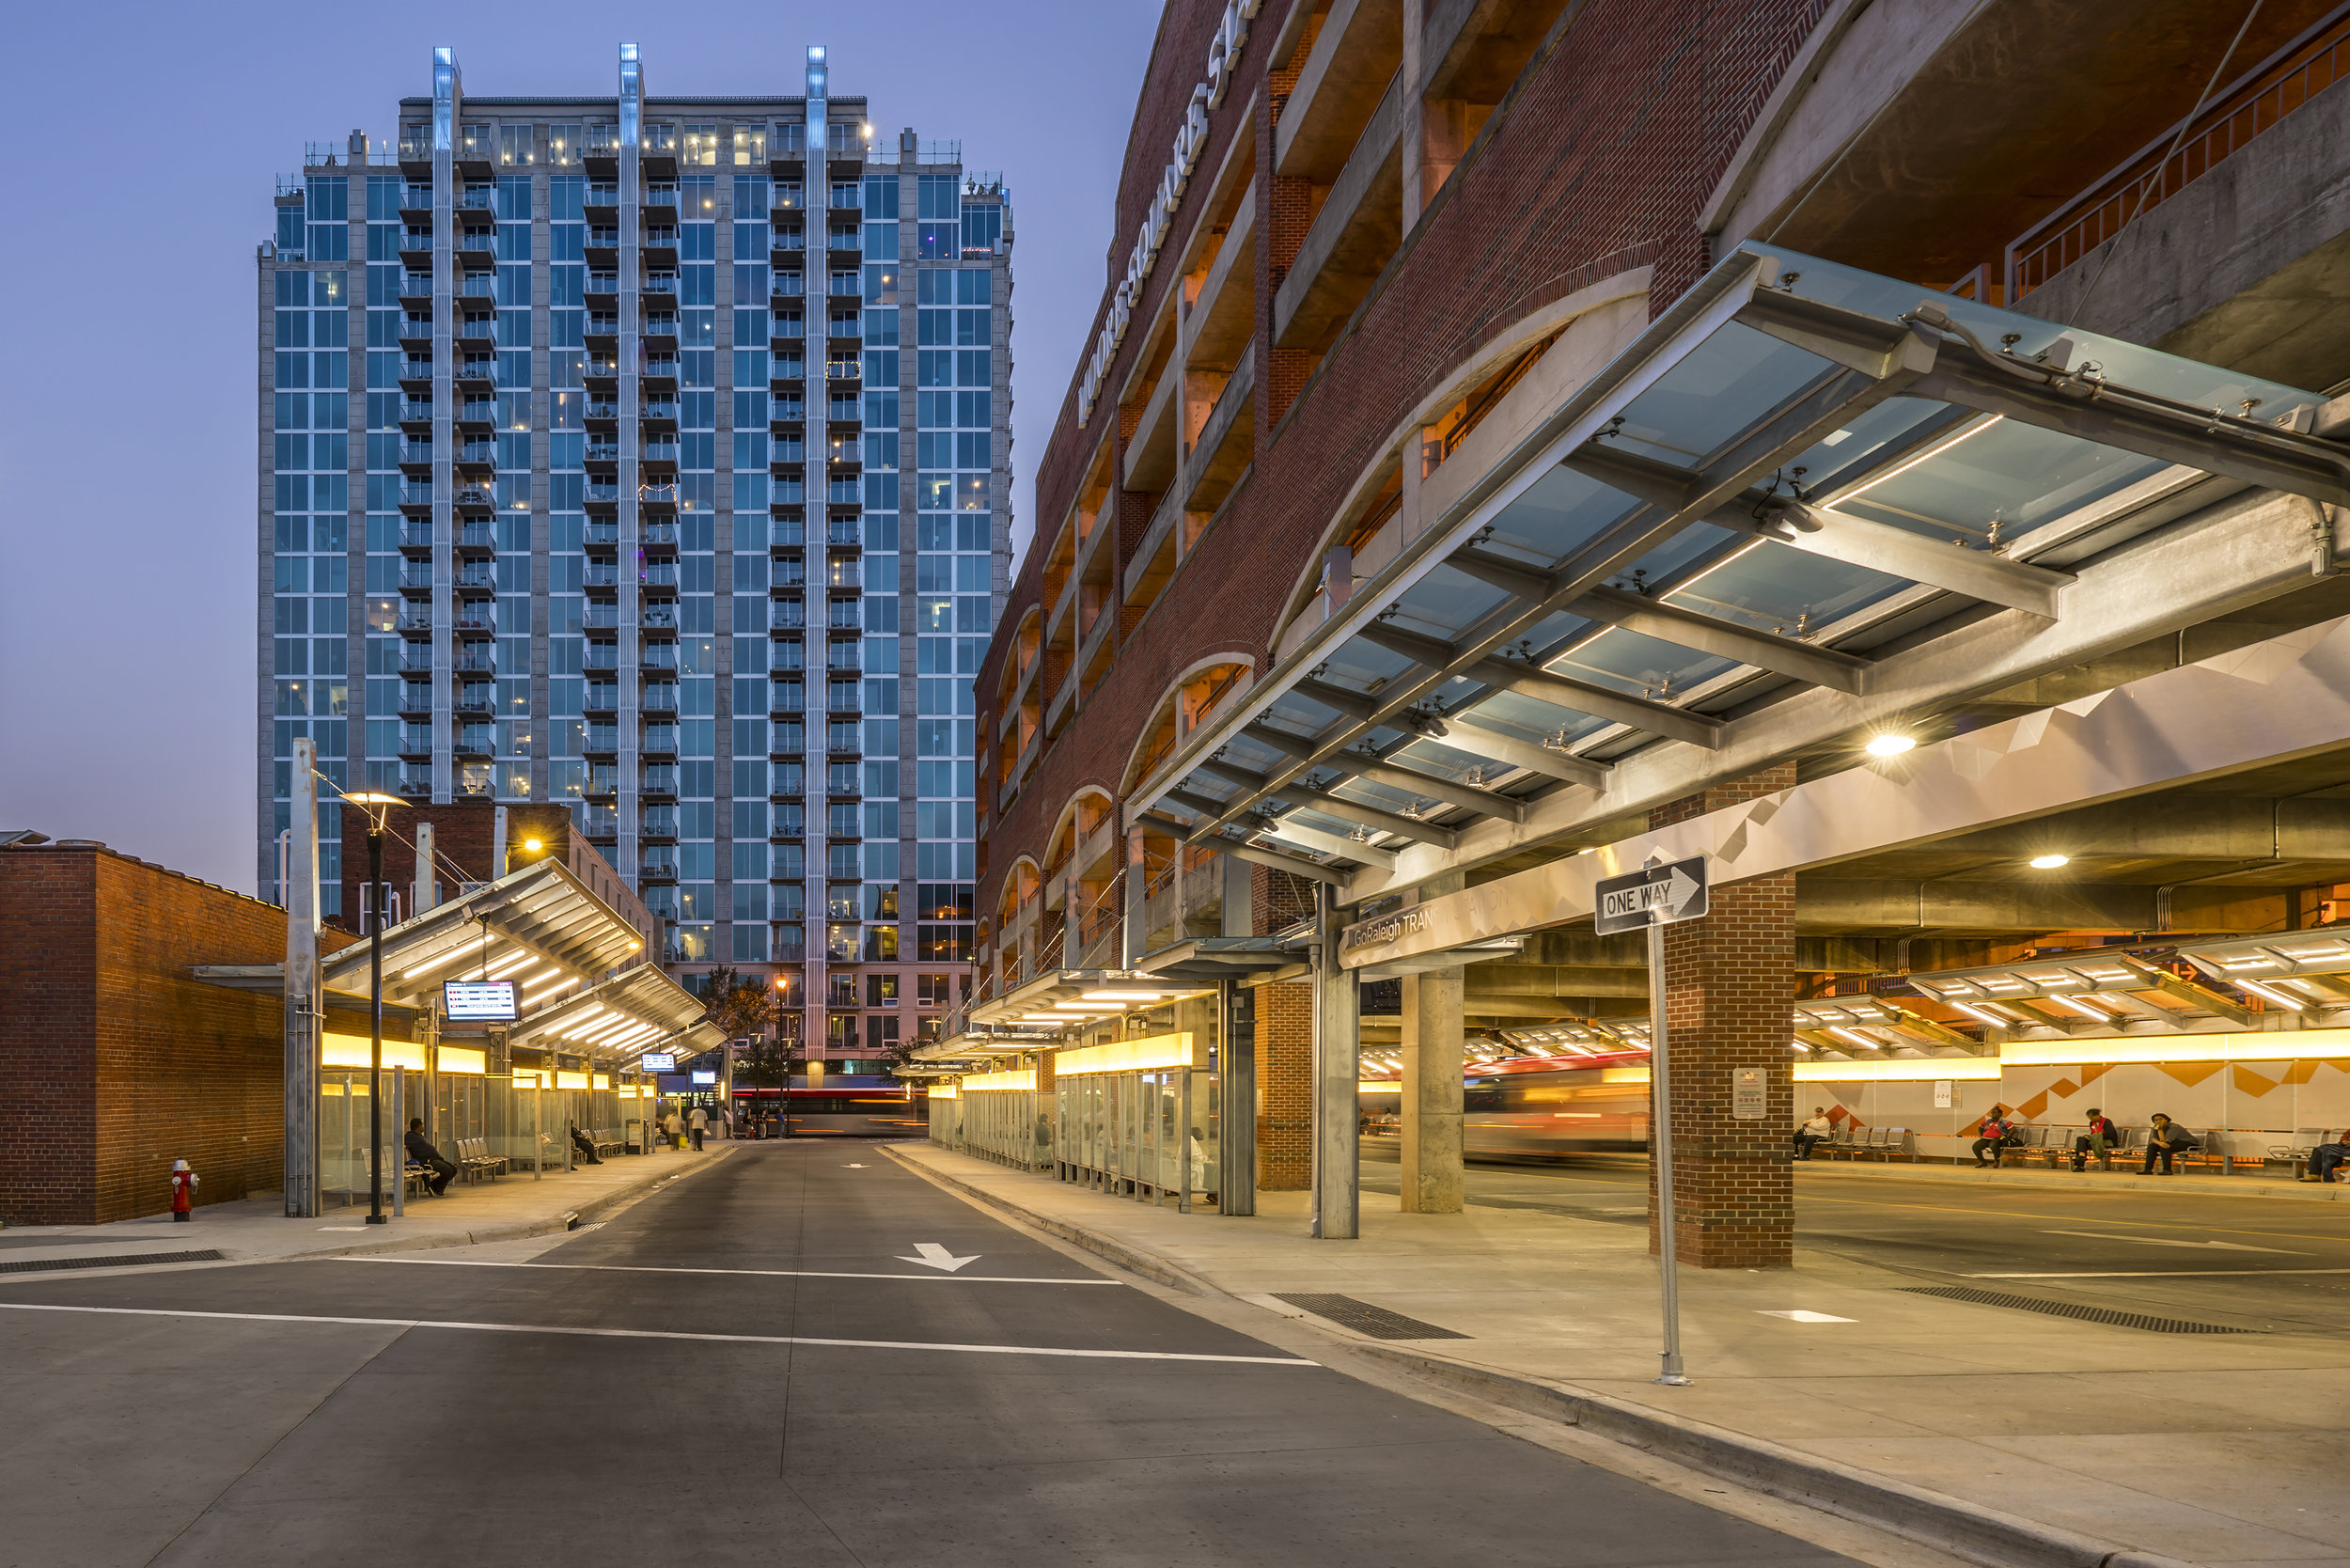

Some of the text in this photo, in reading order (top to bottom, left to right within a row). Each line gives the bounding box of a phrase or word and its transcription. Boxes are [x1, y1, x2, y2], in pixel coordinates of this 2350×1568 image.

[1078, 280, 1129, 429] MOORE
[1128, 83, 1208, 307] SQUARE
[1606, 881, 1672, 915] ONE WAY
[1355, 917, 1401, 947] GoRaleigh
